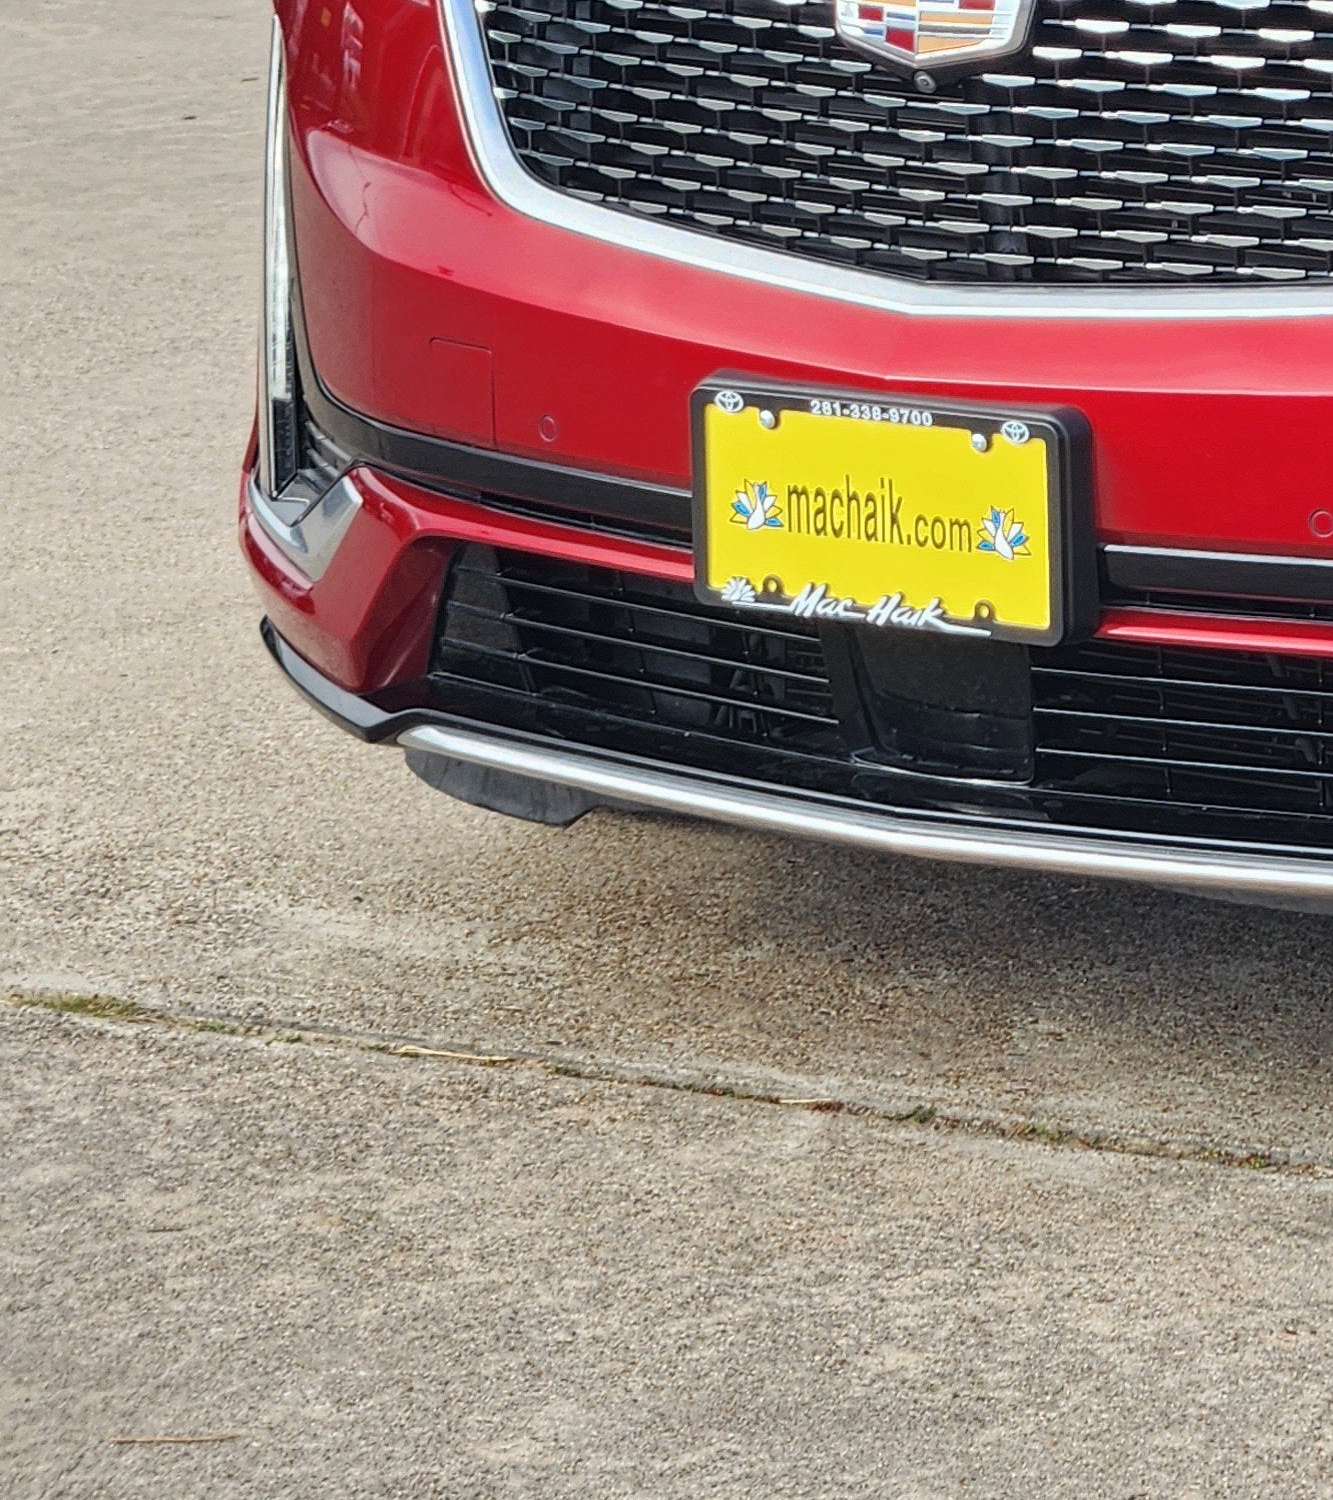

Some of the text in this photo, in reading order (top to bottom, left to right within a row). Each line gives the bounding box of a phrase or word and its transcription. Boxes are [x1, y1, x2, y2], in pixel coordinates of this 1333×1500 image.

[810, 398, 933, 427] 281-338-9700
[787, 475, 973, 553] machaik.com
[789, 582, 962, 631] Mac Haik
